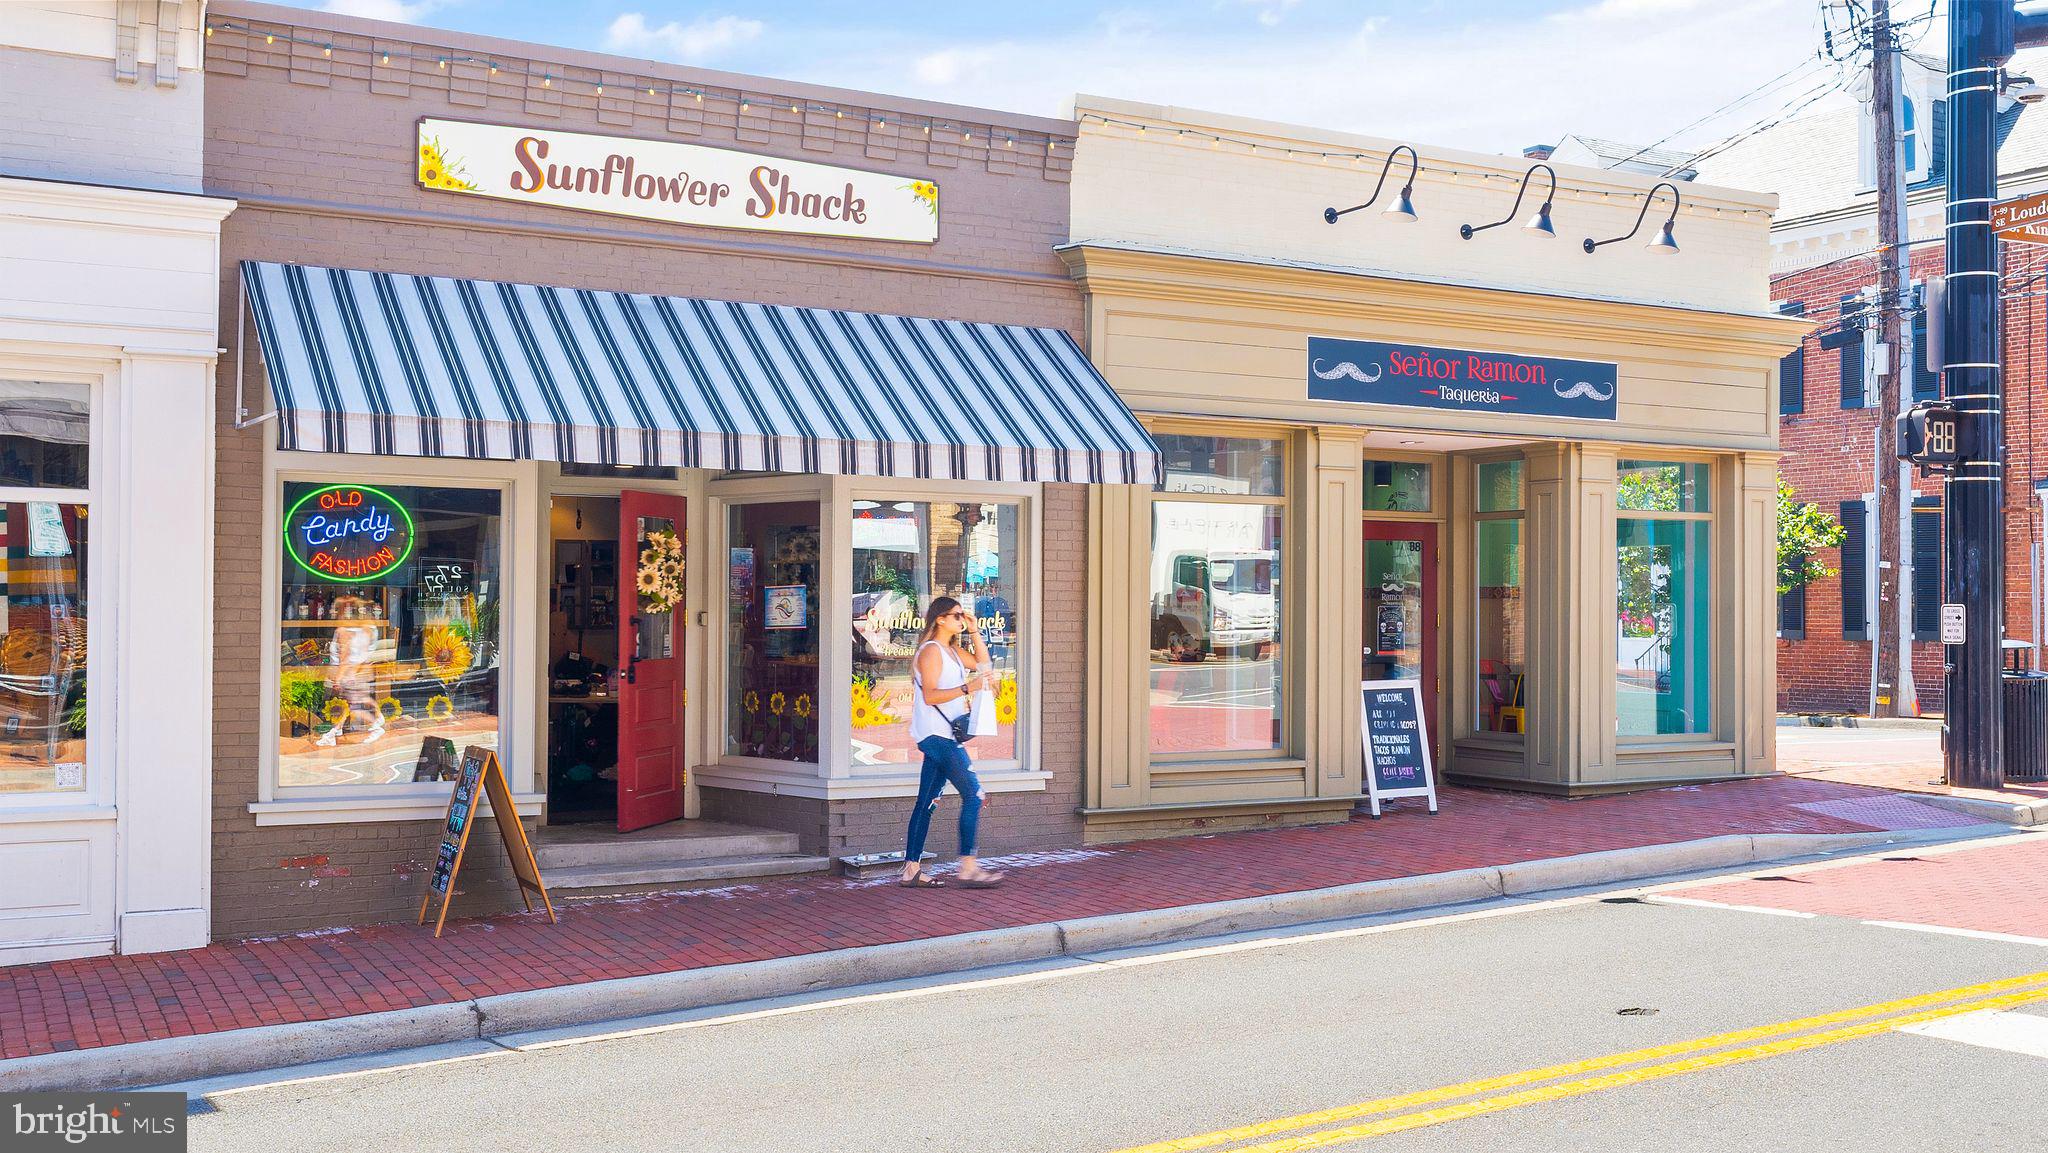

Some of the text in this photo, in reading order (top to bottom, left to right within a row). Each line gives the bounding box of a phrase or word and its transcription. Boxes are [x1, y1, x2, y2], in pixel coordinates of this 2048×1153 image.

[509, 136, 868, 225] Sunflower Shack
[1993, 206, 2008, 216] 1-99
[1995, 217, 2006, 227] SE
[1389, 351, 1547, 385] Señor Ramon
[320, 490, 362, 509] OLD
[301, 505, 395, 545] Candy
[310, 544, 395, 577] FASHION
[864, 608, 927, 633] Sunflo
[1376, 693, 1403, 702] WELCOME
[1373, 745, 1390, 755] TACOS
